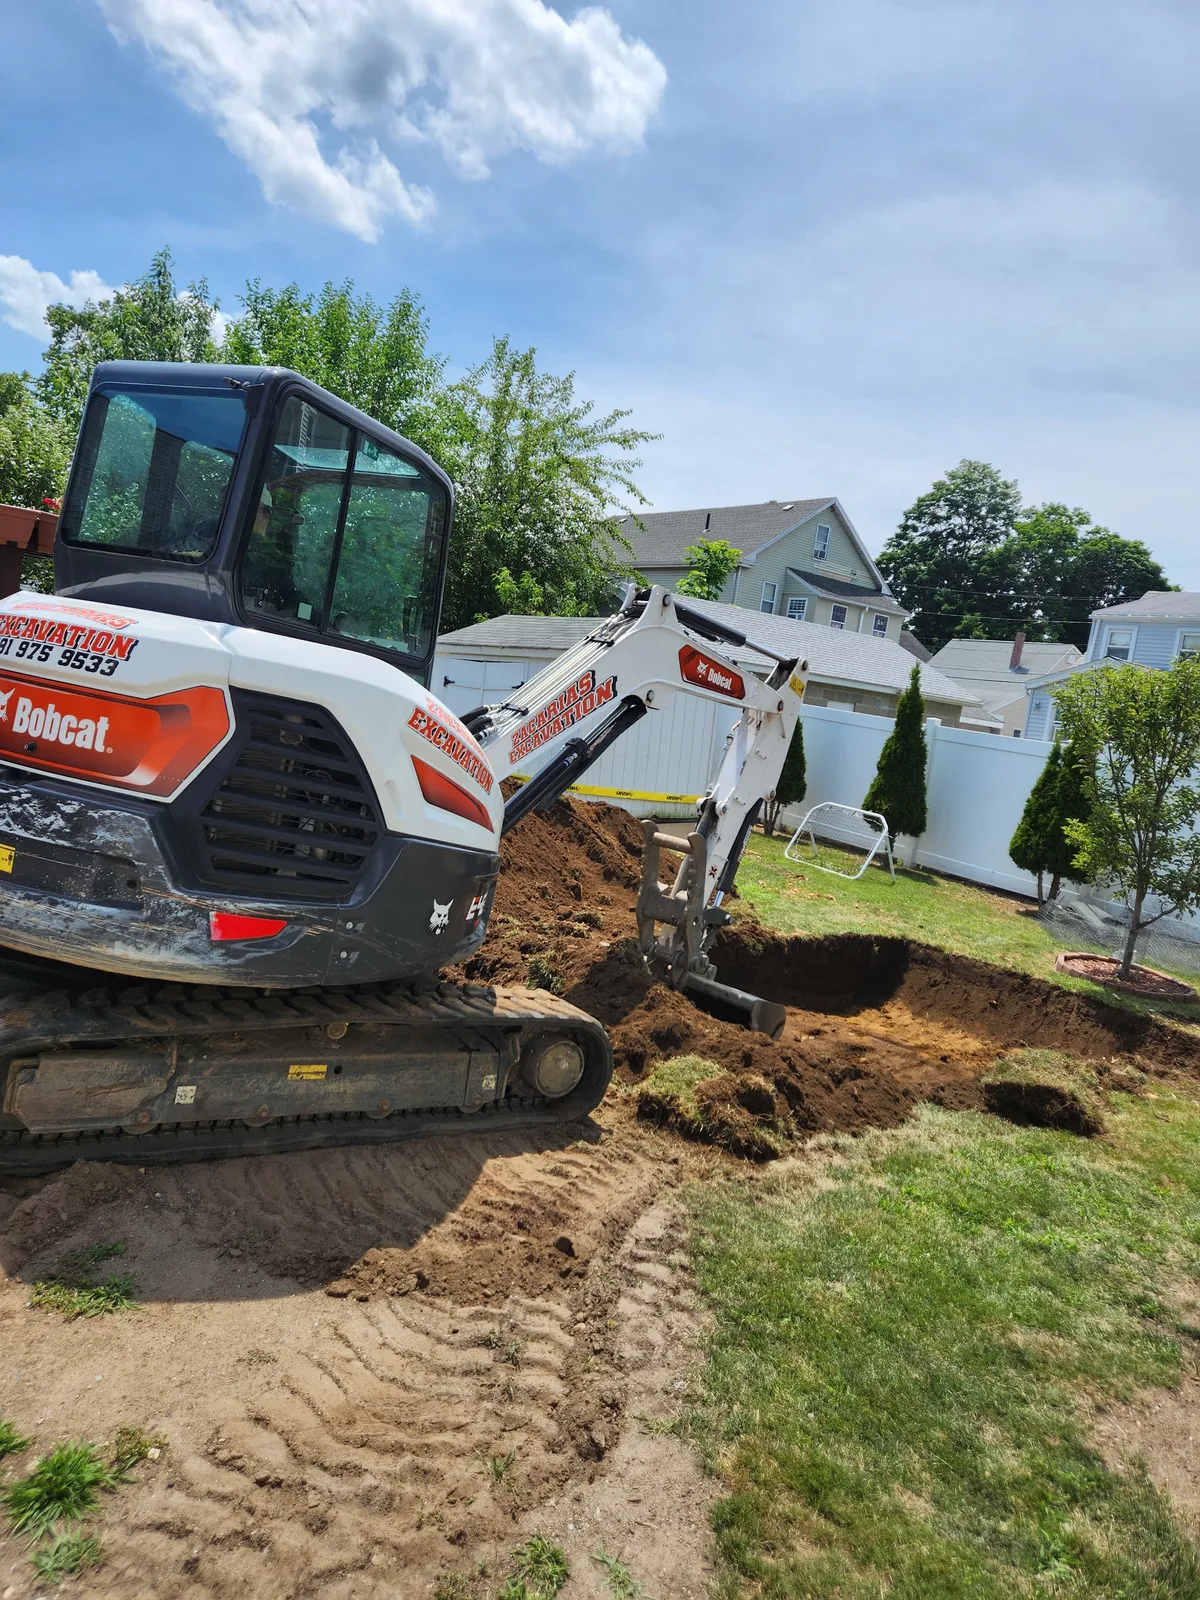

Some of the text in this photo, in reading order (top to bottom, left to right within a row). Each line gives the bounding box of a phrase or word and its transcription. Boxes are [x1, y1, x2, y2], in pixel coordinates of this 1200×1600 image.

[0, 613, 139, 661] EXCAVATION
[16, 641, 54, 662] 975
[58, 649, 120, 677] 9533
[708, 668, 732, 691] Bobcat
[12, 697, 110, 754] Bobcat
[508, 675, 618, 765] EXCAVATION
[511, 670, 596, 749] ZACARIAS
[405, 705, 494, 796] EXCAVATION
